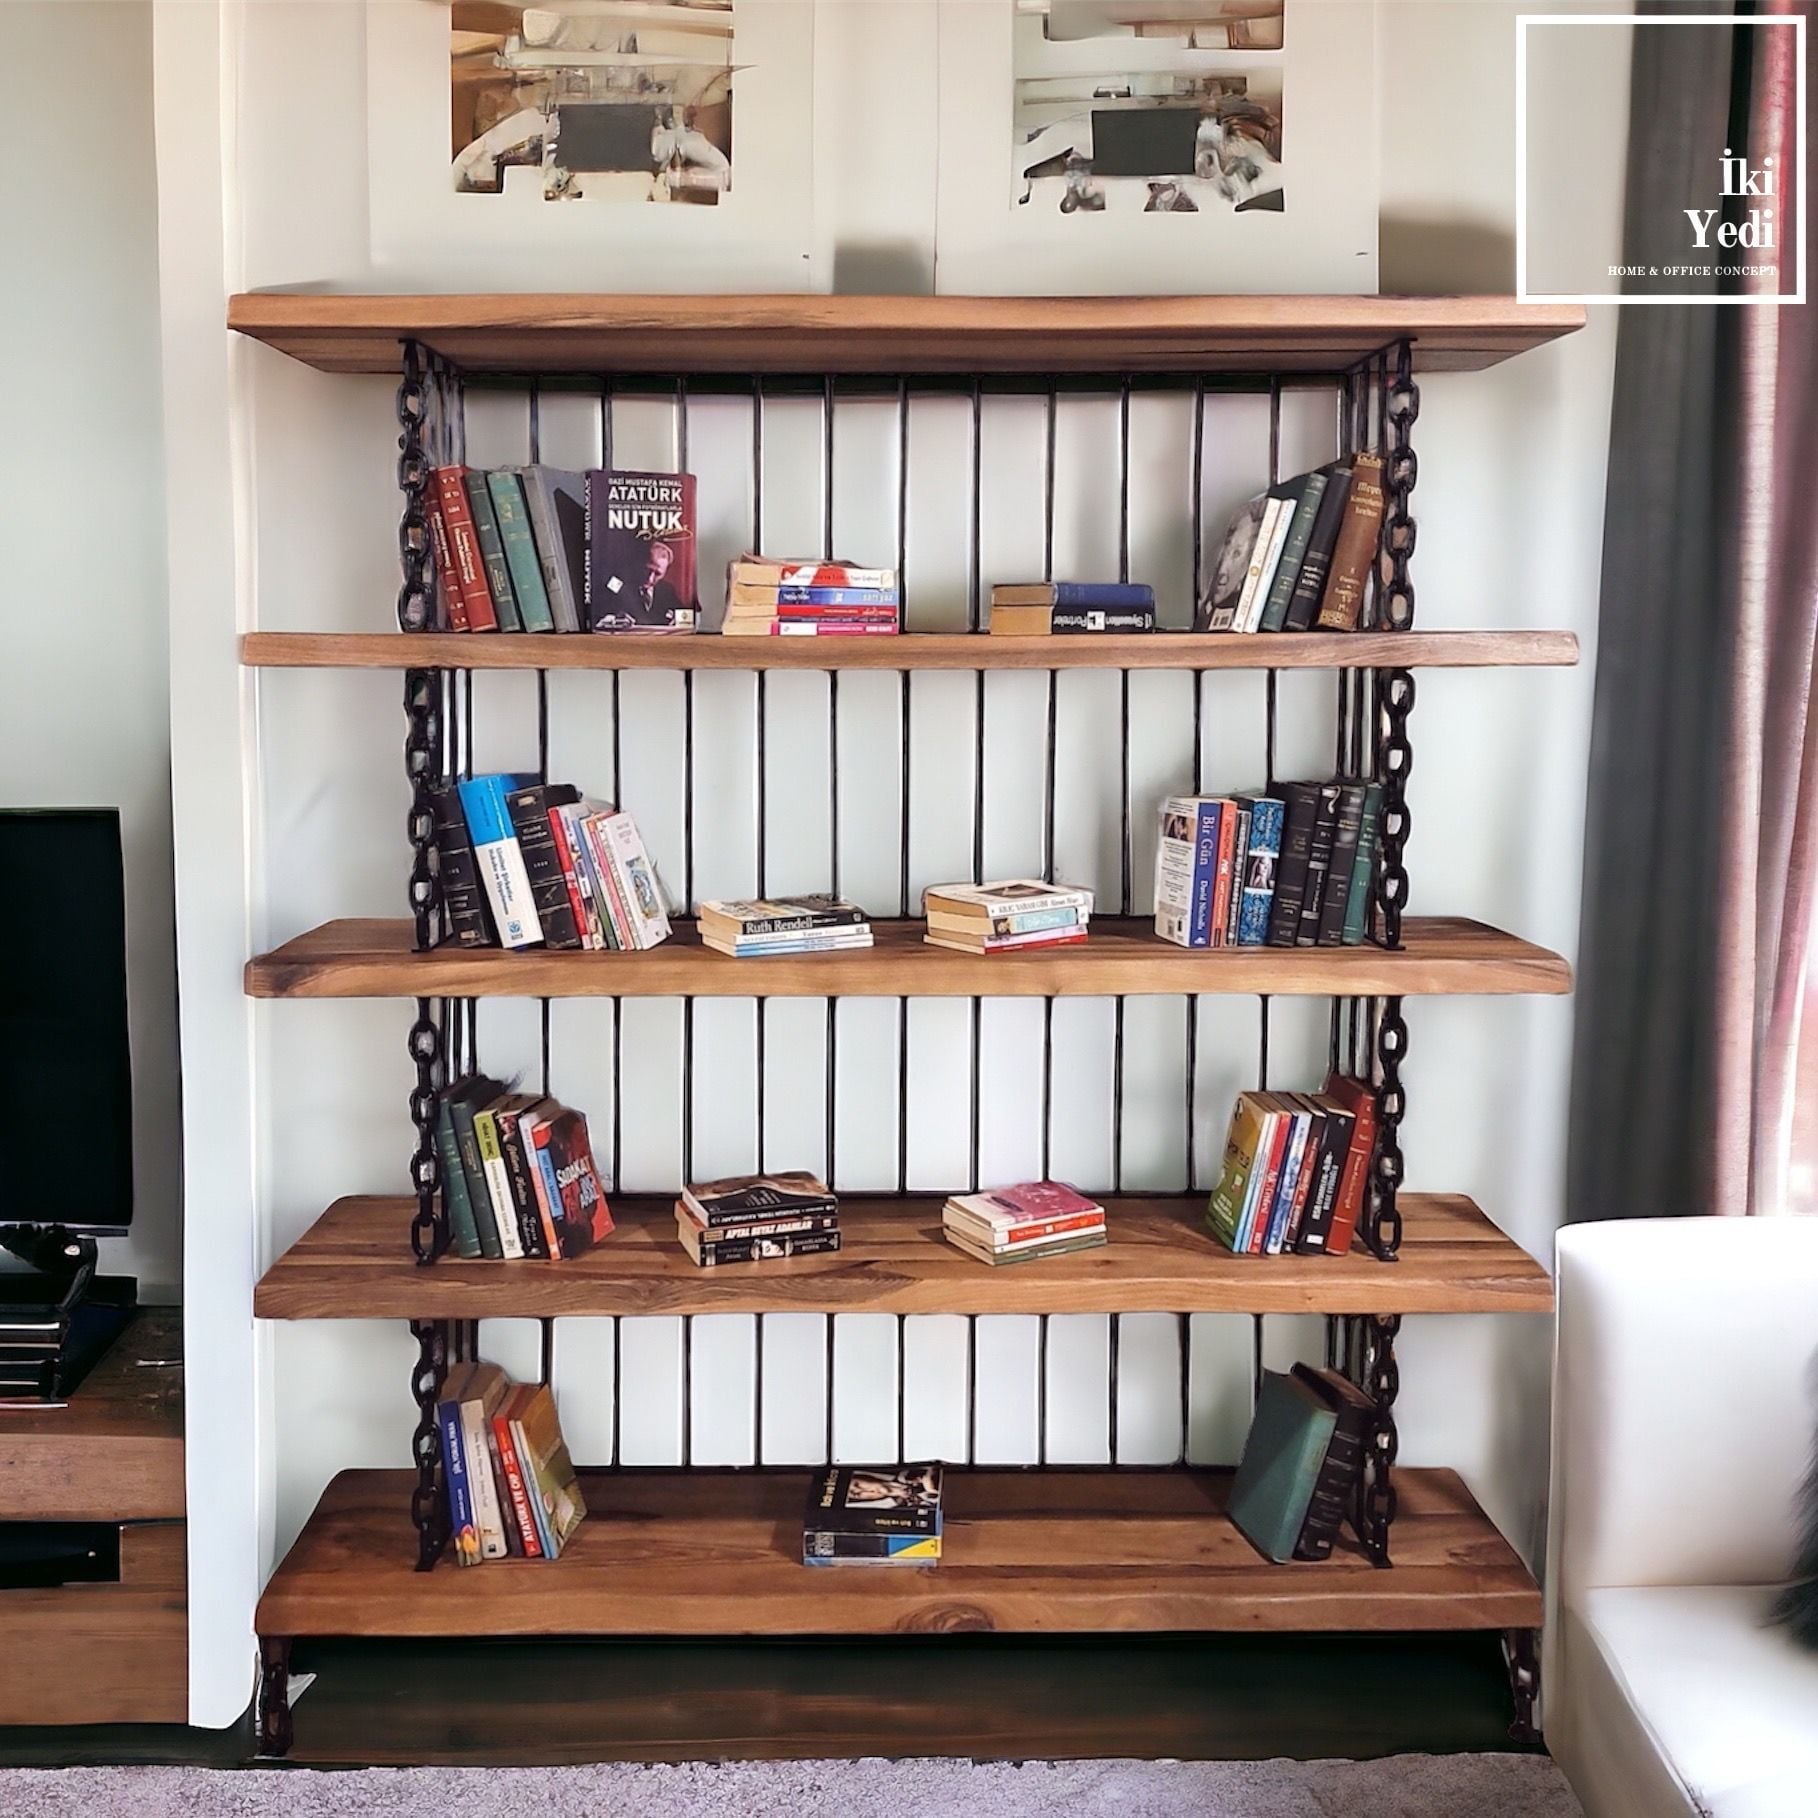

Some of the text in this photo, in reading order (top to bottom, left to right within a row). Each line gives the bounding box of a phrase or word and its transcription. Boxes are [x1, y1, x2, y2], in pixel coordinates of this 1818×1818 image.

[608, 486, 683, 502] ATATÜRK
[608, 510, 683, 530] NUTUK
[1198, 815, 1215, 865] Bir Gün
[1198, 879, 1208, 901] David
[746, 916, 813, 934] Ruth Rendell
[514, 1501, 534, 1542] ATATÜRK
